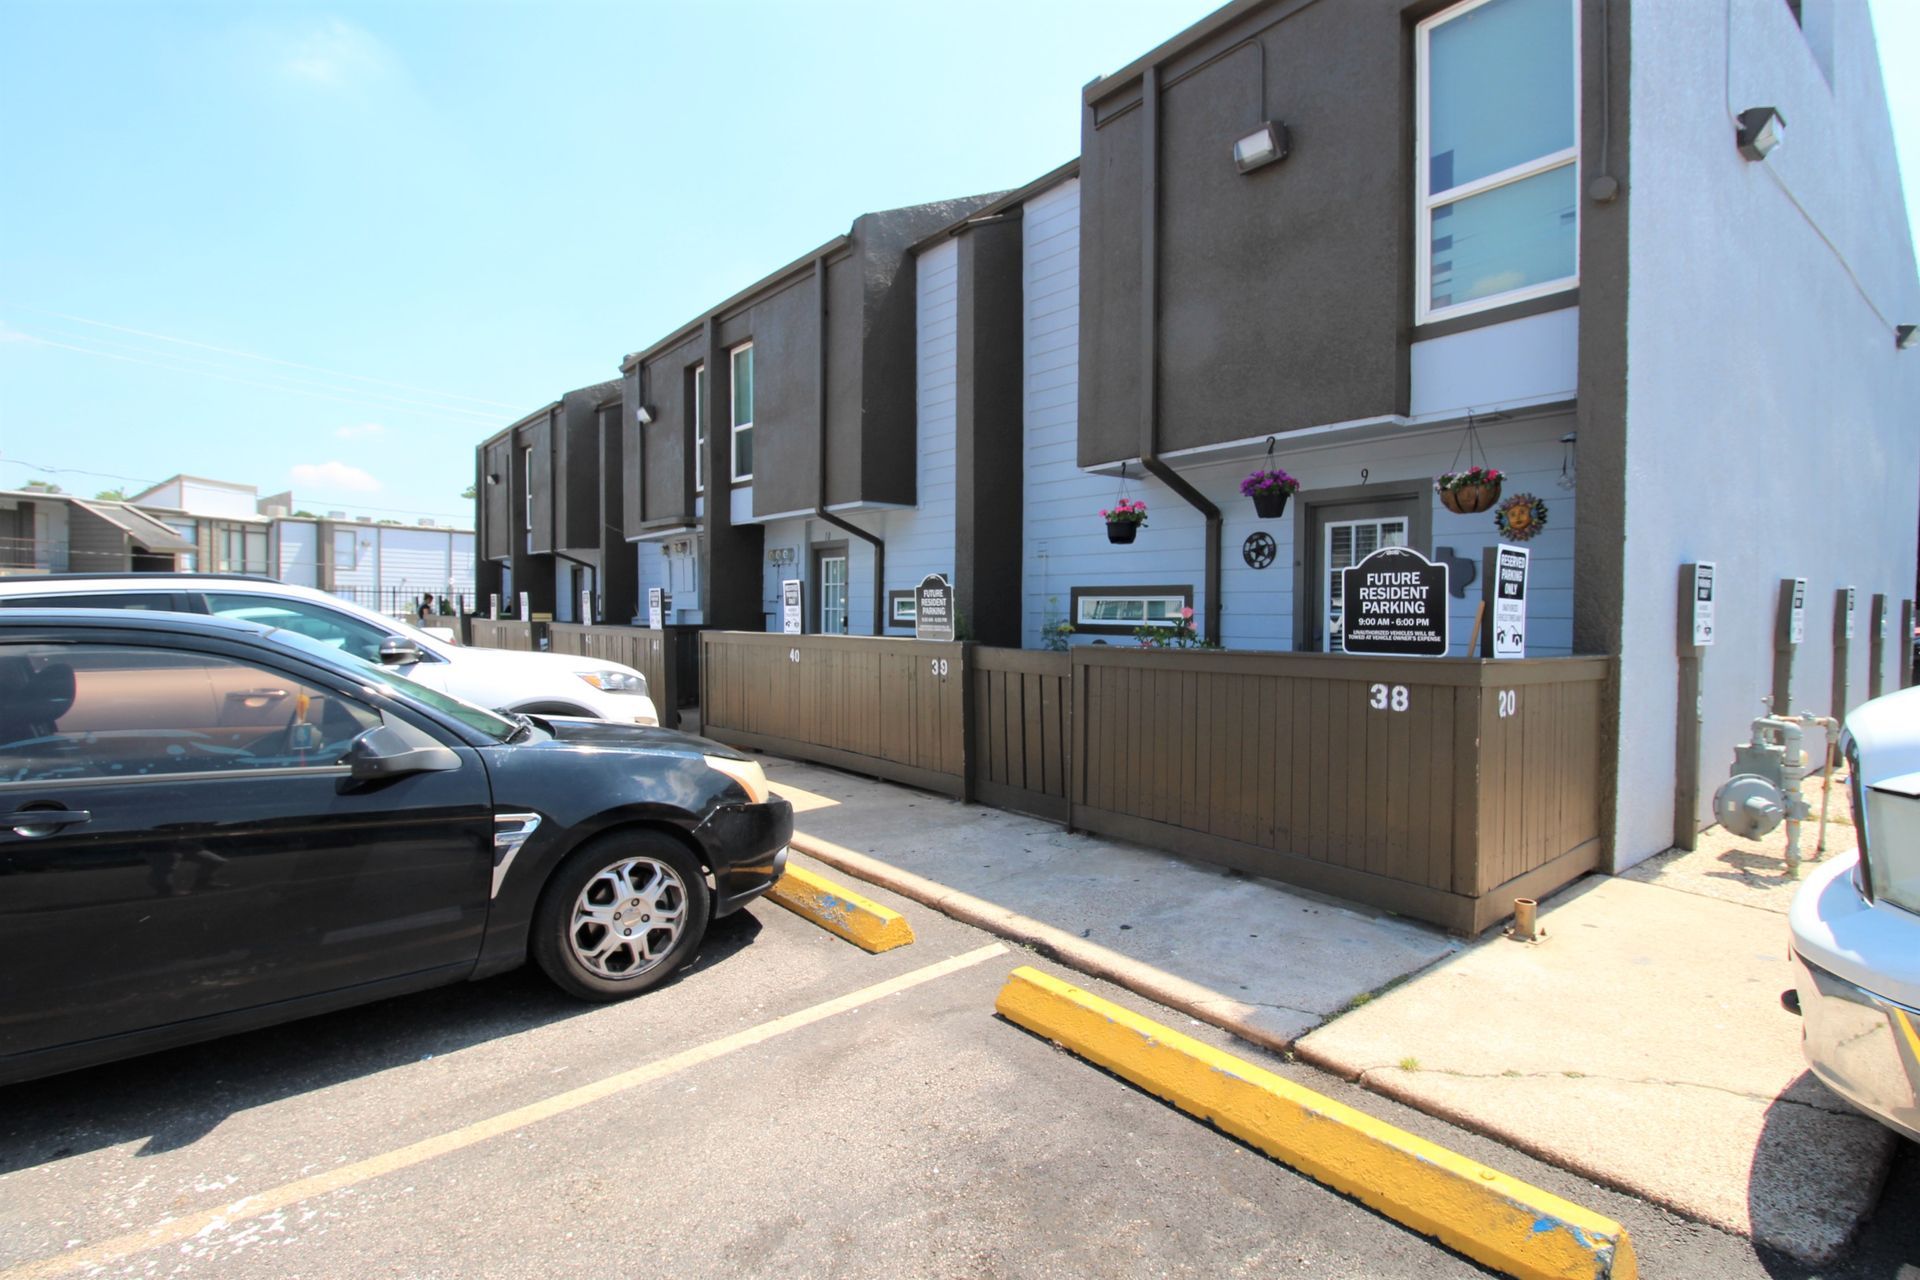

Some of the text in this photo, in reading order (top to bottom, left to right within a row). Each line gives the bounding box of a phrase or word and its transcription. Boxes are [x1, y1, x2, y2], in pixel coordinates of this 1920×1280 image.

[1361, 468, 1369, 487] 9
[1501, 554, 1526, 568] RESERVED
[1367, 572, 1421, 585] FUTURE
[1501, 568, 1523, 582] PARKING
[923, 589, 944, 598] FUTURE
[1360, 586, 1429, 600] RESIDENT
[1504, 582, 1518, 595] ONLY
[921, 598, 947, 607] RESIDENT
[1362, 601, 1425, 614] PARKING
[922, 607, 946, 616] PARKING
[1358, 617, 1376, 626] 9:00
[1377, 618, 1390, 626] AM
[1395, 617, 1414, 626] 6:00
[1416, 618, 1430, 626] PM
[790, 648, 800, 663] 40
[932, 659, 948, 675] 39
[1370, 683, 1409, 712] 38
[1499, 690, 1515, 718] 20
